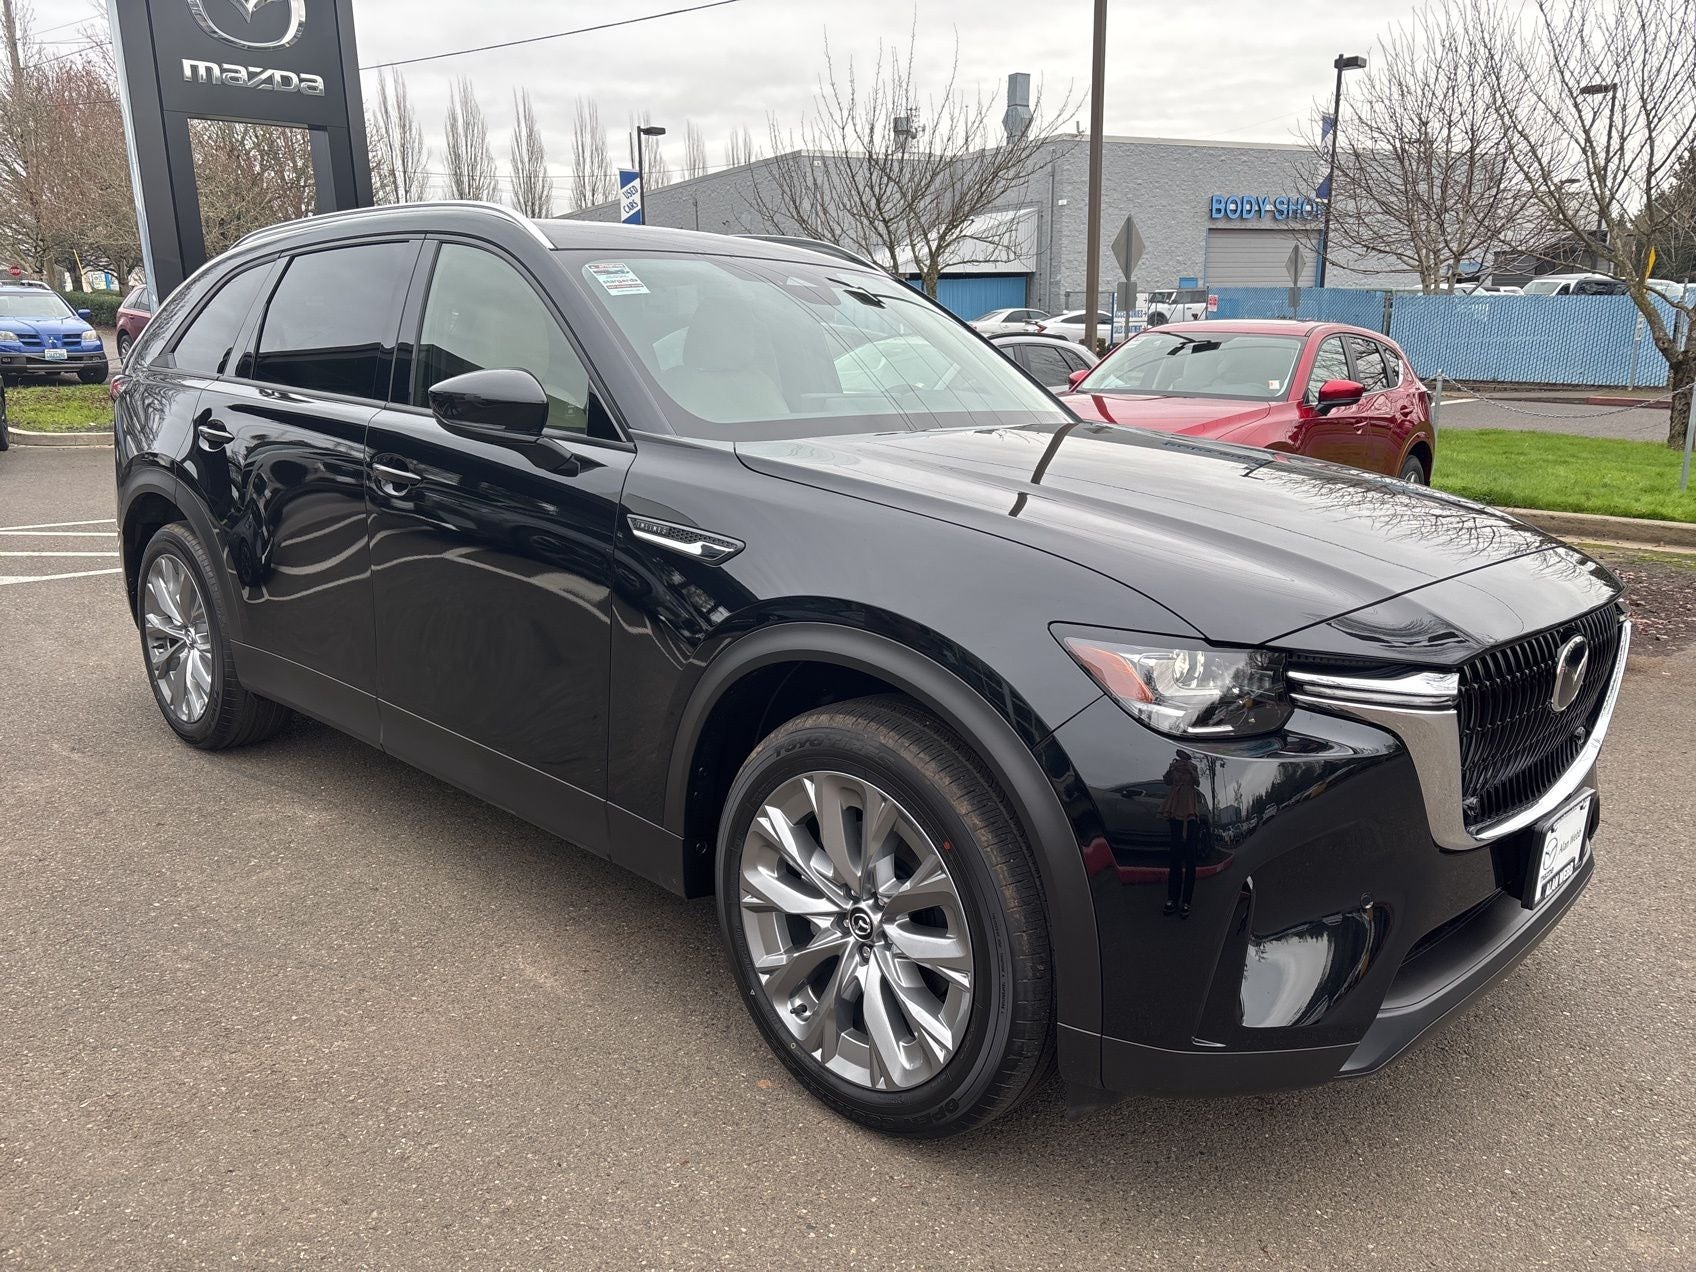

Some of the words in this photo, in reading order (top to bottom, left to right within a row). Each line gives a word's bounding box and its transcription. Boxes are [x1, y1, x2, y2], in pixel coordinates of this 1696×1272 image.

[181, 58, 325, 97] mazda
[622, 185, 639, 199] USED
[623, 199, 639, 214] CARS
[1210, 194, 1269, 220] BODY
